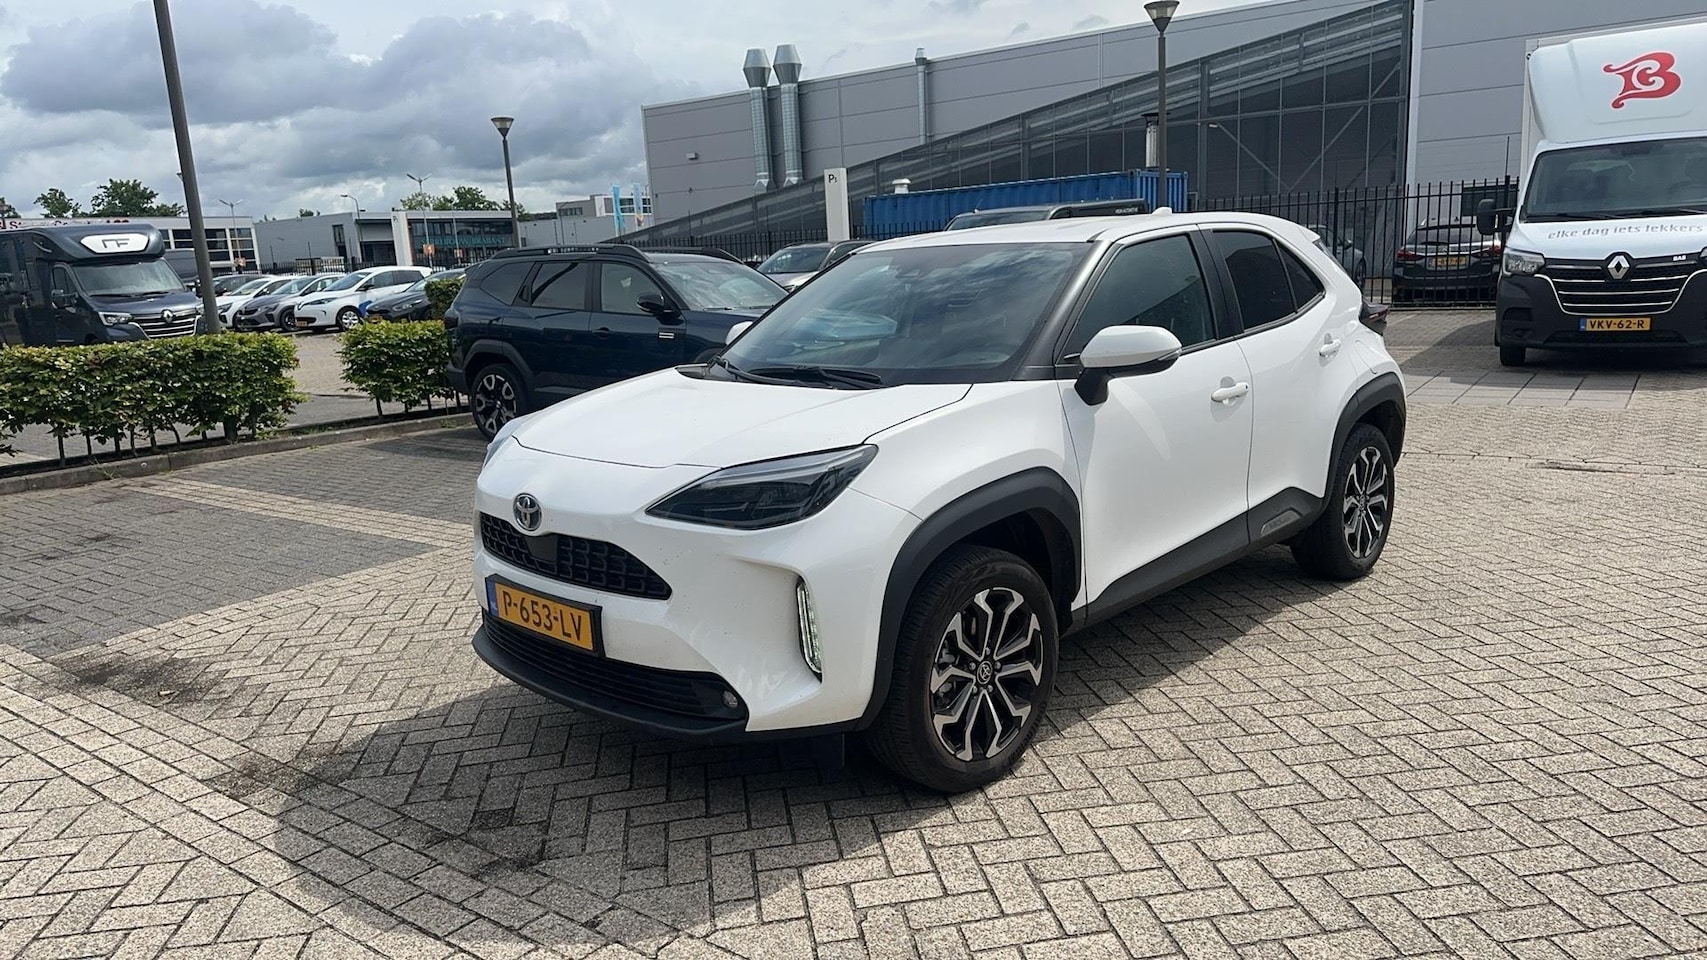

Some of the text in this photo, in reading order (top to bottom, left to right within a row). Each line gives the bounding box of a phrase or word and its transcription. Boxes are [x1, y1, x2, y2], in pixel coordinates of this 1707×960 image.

[1548, 223, 1703, 239] elke dag iets lekkers
[1590, 319, 1644, 329] VKV-62-R
[502, 590, 582, 641] P-653-LV
